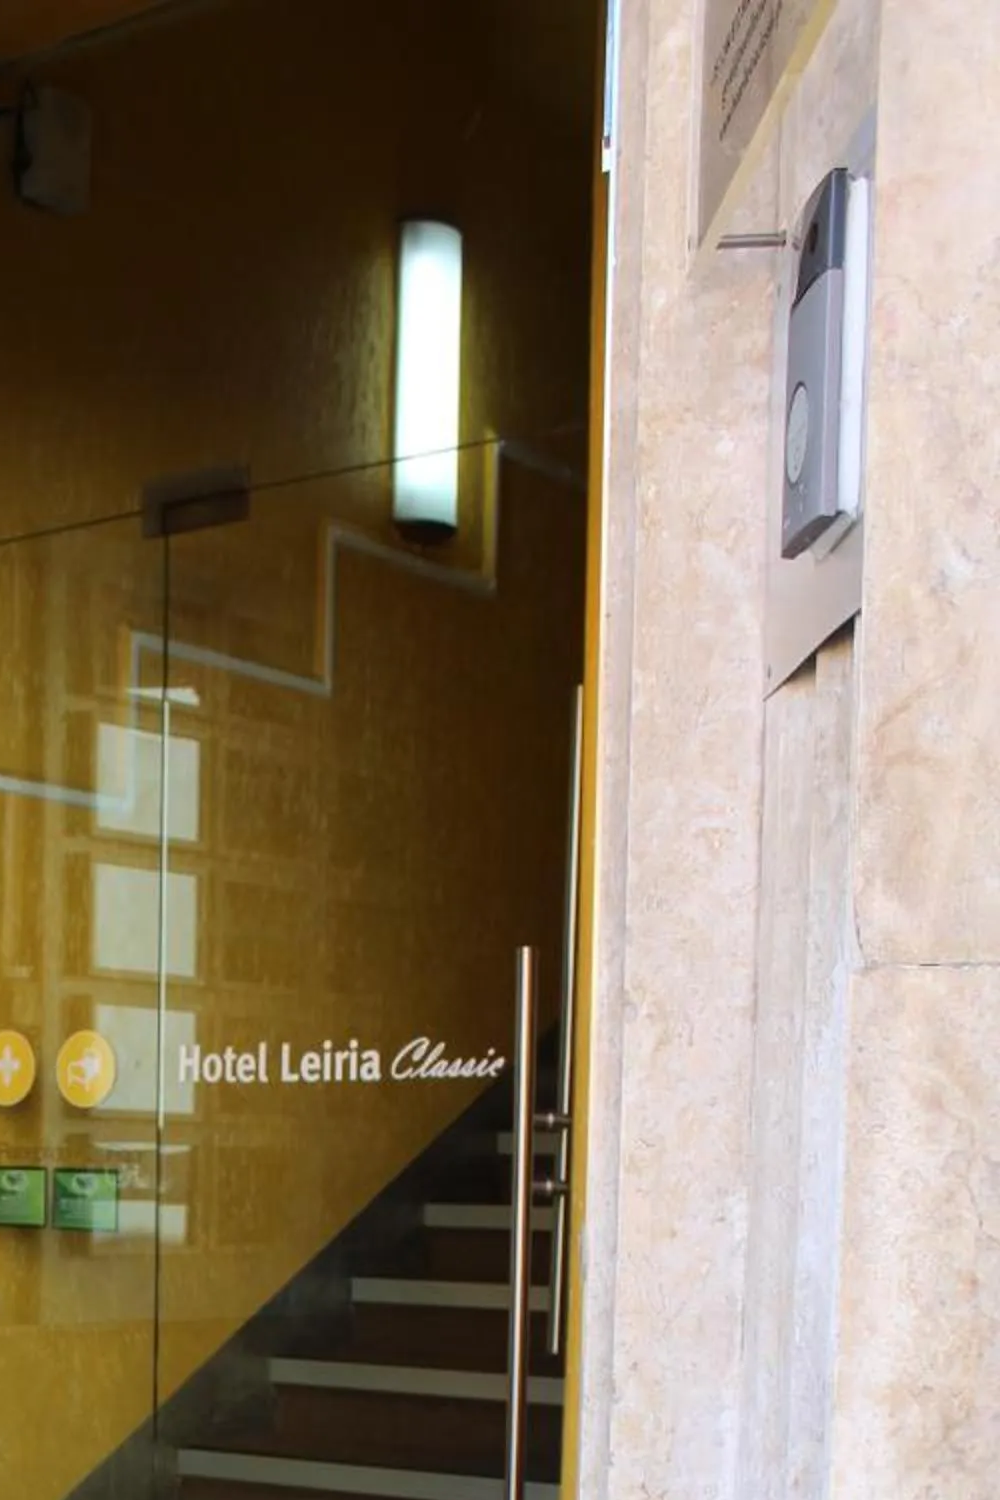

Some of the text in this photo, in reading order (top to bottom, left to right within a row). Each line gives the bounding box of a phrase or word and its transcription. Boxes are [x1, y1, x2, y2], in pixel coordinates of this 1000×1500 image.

[177, 1035, 508, 1084] Hotel Leiria Classic
